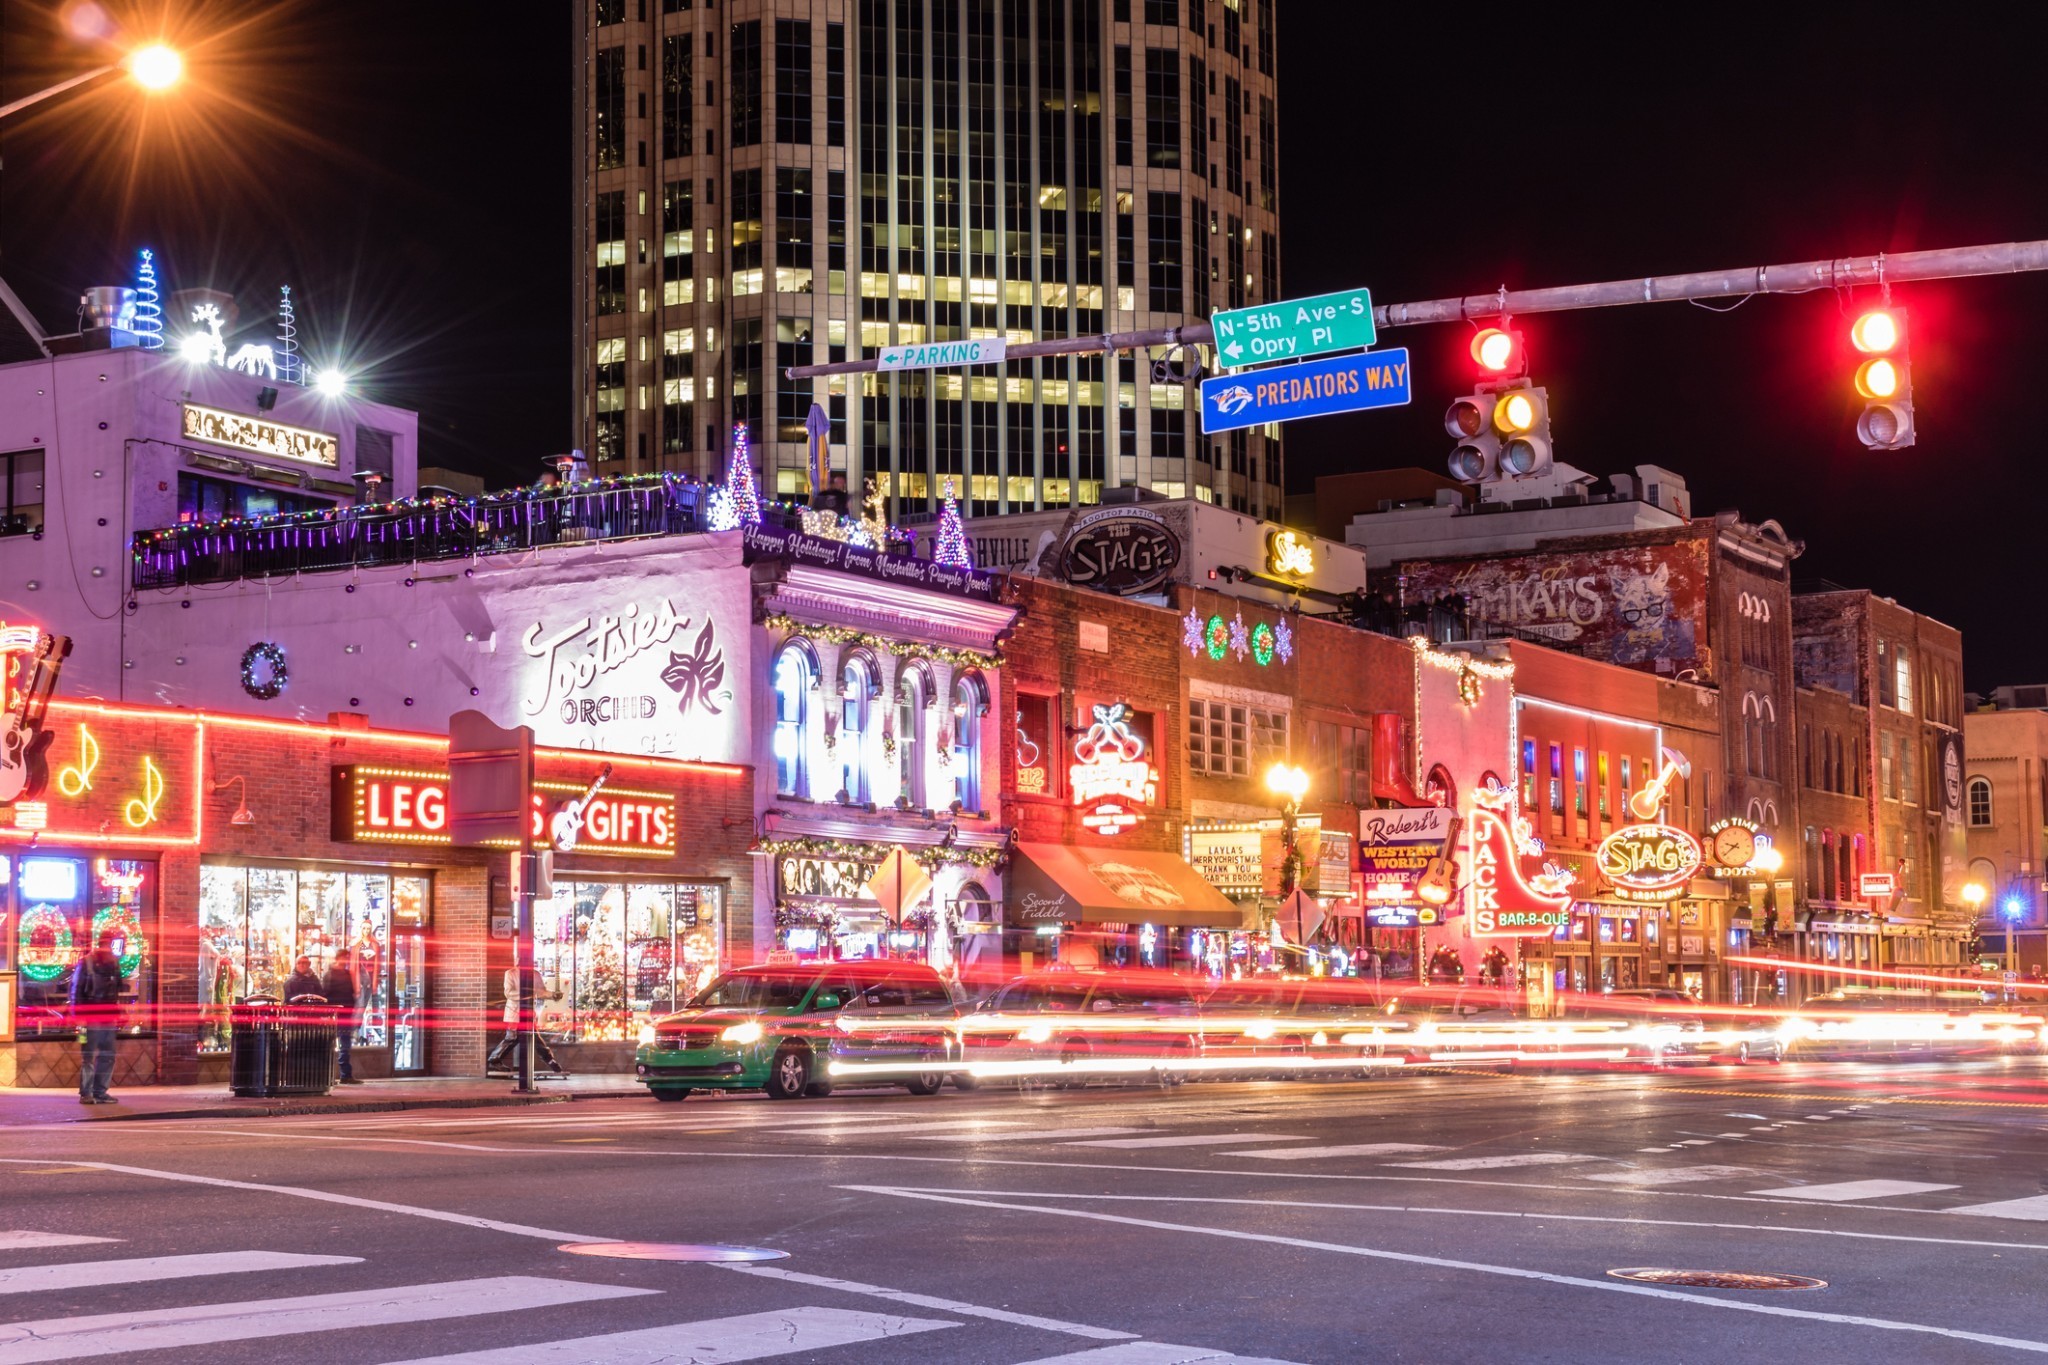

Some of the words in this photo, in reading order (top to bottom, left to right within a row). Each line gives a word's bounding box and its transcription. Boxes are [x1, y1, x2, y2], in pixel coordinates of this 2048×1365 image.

[1250, 336, 1297, 360] Opry
[1313, 329, 1332, 347] Pl
[902, 343, 980, 366] PARKING
[1255, 369, 1359, 408] PREDATORS
[1366, 362, 1407, 393] WAY
[1082, 509, 1123, 526] ROOFTOP
[1126, 508, 1154, 519] PATIO
[1107, 523, 1131, 538] THE
[743, 523, 784, 553] Happy
[787, 533, 842, 565] Holidays!
[875, 555, 925, 582] Nashville's
[928, 563, 963, 592] Purple
[1069, 533, 1173, 581] STAGE
[521, 599, 691, 716] Tootsies
[560, 695, 657, 726] ORCHID
[586, 800, 668, 845] GIFTS
[1367, 810, 1440, 846] Robert's
[1710, 819, 1729, 834] BIG
[1731, 817, 1760, 833] TIME
[1208, 846, 1243, 855] LAYLA'S
[1363, 846, 1438, 859] WESTERN
[1603, 835, 1697, 877] STAGE
[1203, 865, 1228, 873] THANK
[1235, 865, 1251, 873] YOU
[1374, 857, 1428, 869] WORLD
[1714, 866, 1757, 877] BOOTS
[1232, 874, 1263, 882] BROOKS
[1365, 872, 1410, 884] HOME
[1411, 871, 1420, 885] of
[1475, 820, 1499, 932] JACKS
[1021, 893, 1066, 908] Second
[1615, 887, 1629, 898] ON
[1632, 886, 1683, 900] BROADWAY
[1021, 906, 1066, 919] Fiddle
[1499, 912, 1570, 927] BAR-B-QUE
